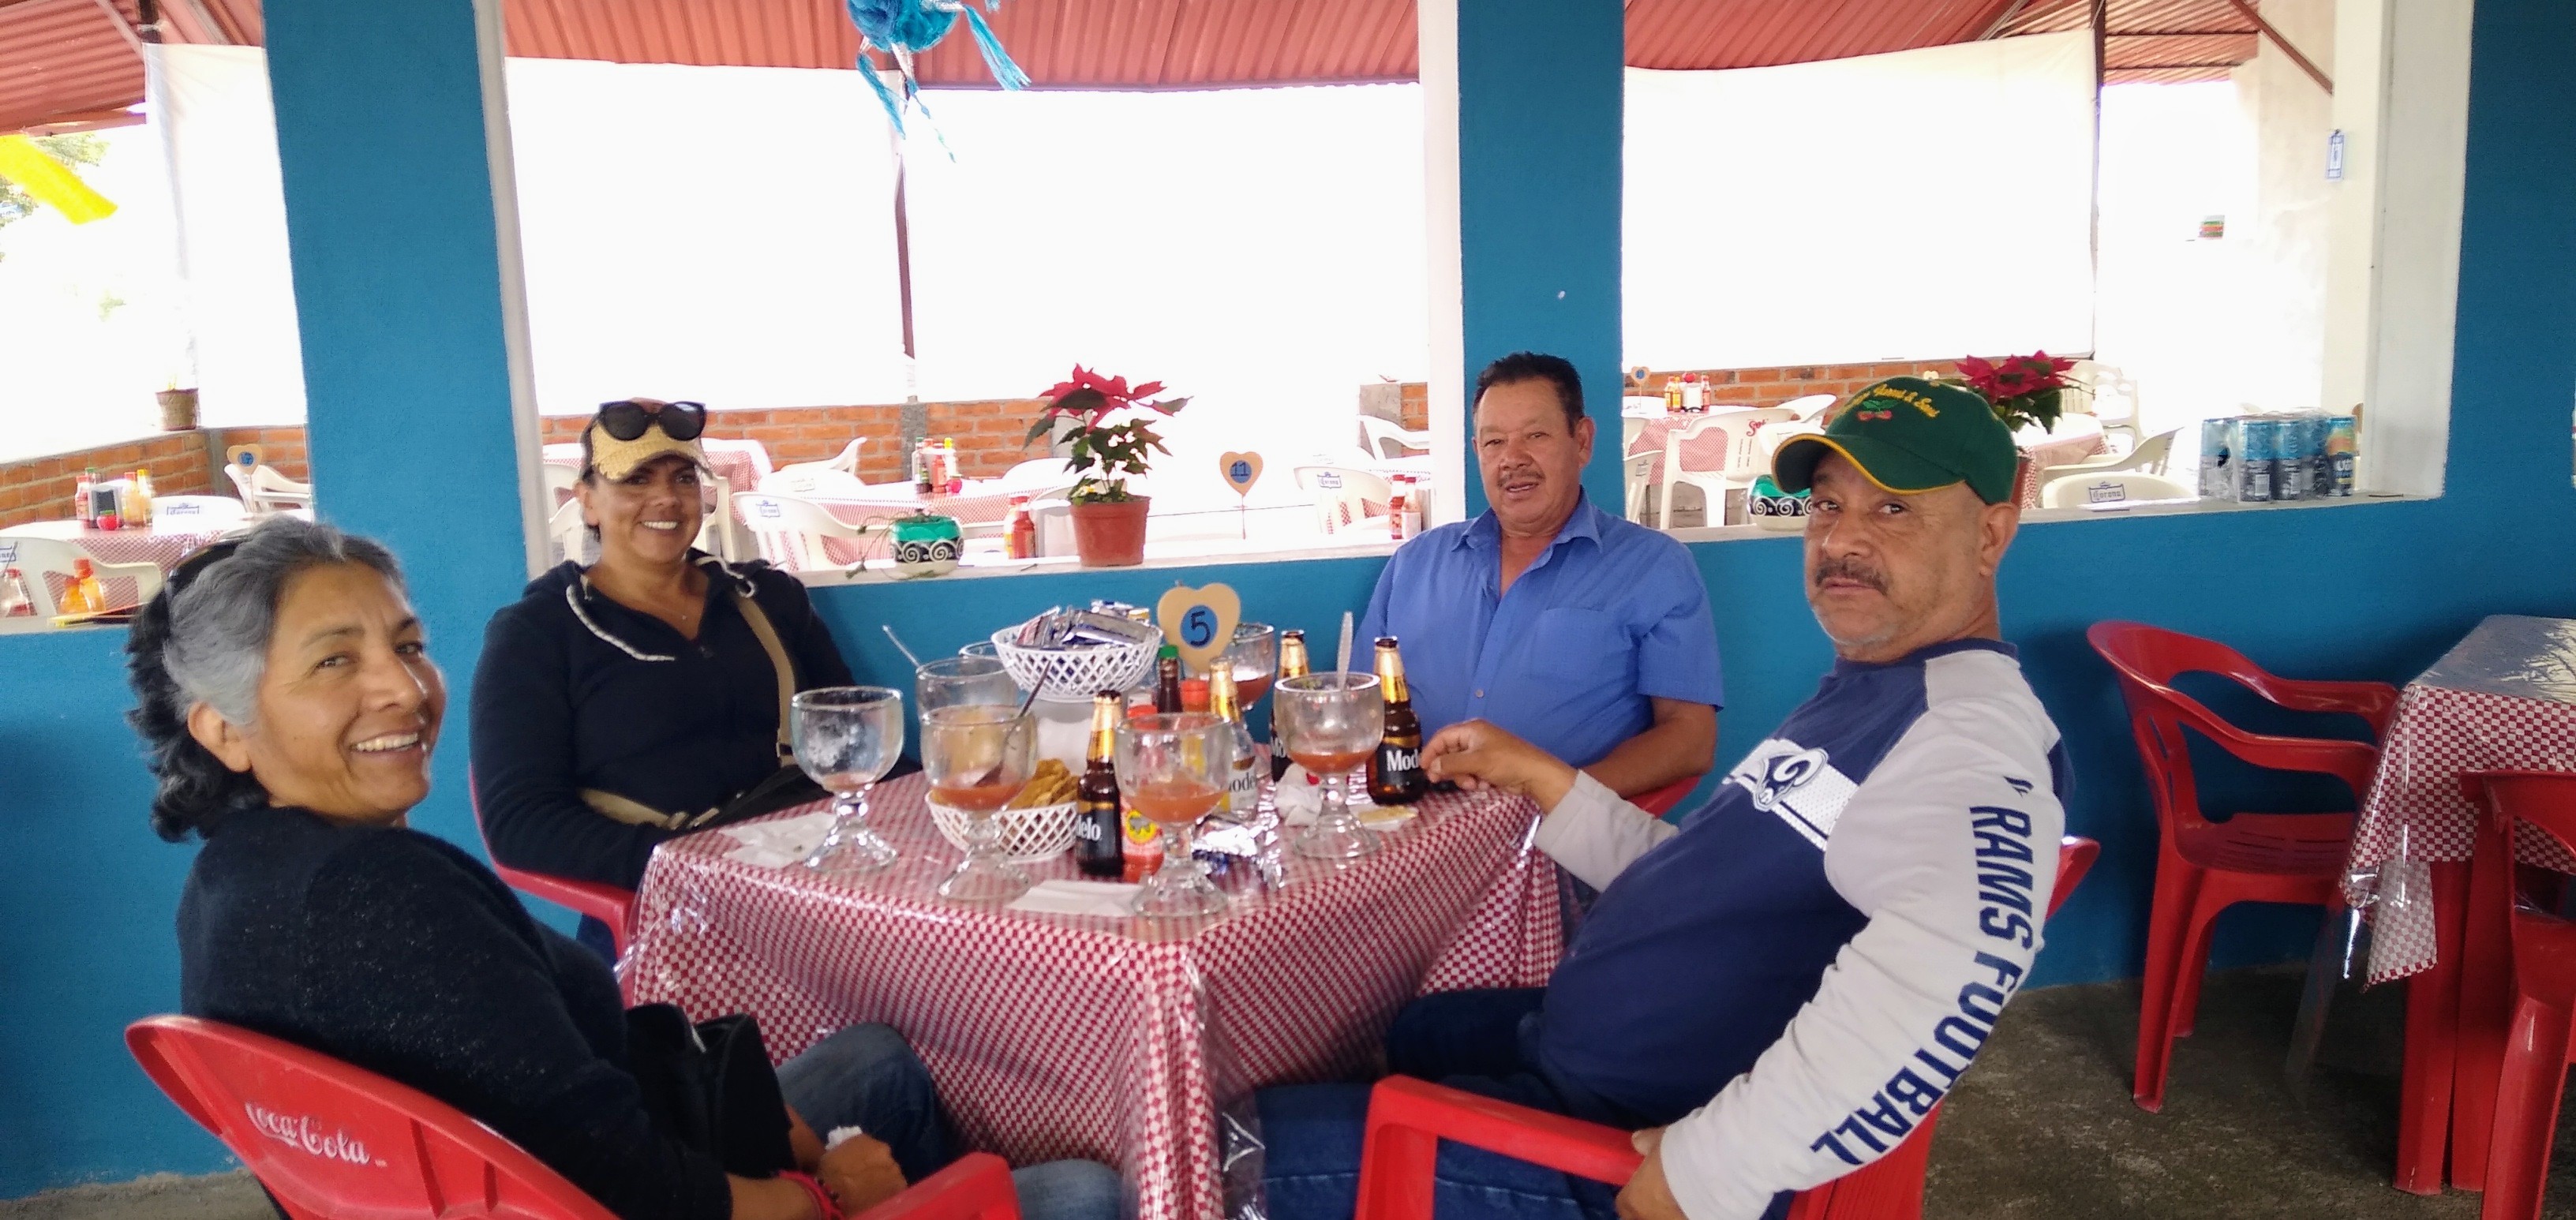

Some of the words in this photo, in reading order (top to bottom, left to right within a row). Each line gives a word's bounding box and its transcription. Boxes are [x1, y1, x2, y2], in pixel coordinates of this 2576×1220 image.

[1230, 462, 1249, 477] 11
[1190, 610, 1211, 647] 5
[1970, 806, 2034, 950] RAMS
[1810, 950, 2024, 1166] FOOTBALL
[245, 1103, 369, 1165] Coca-Cola
